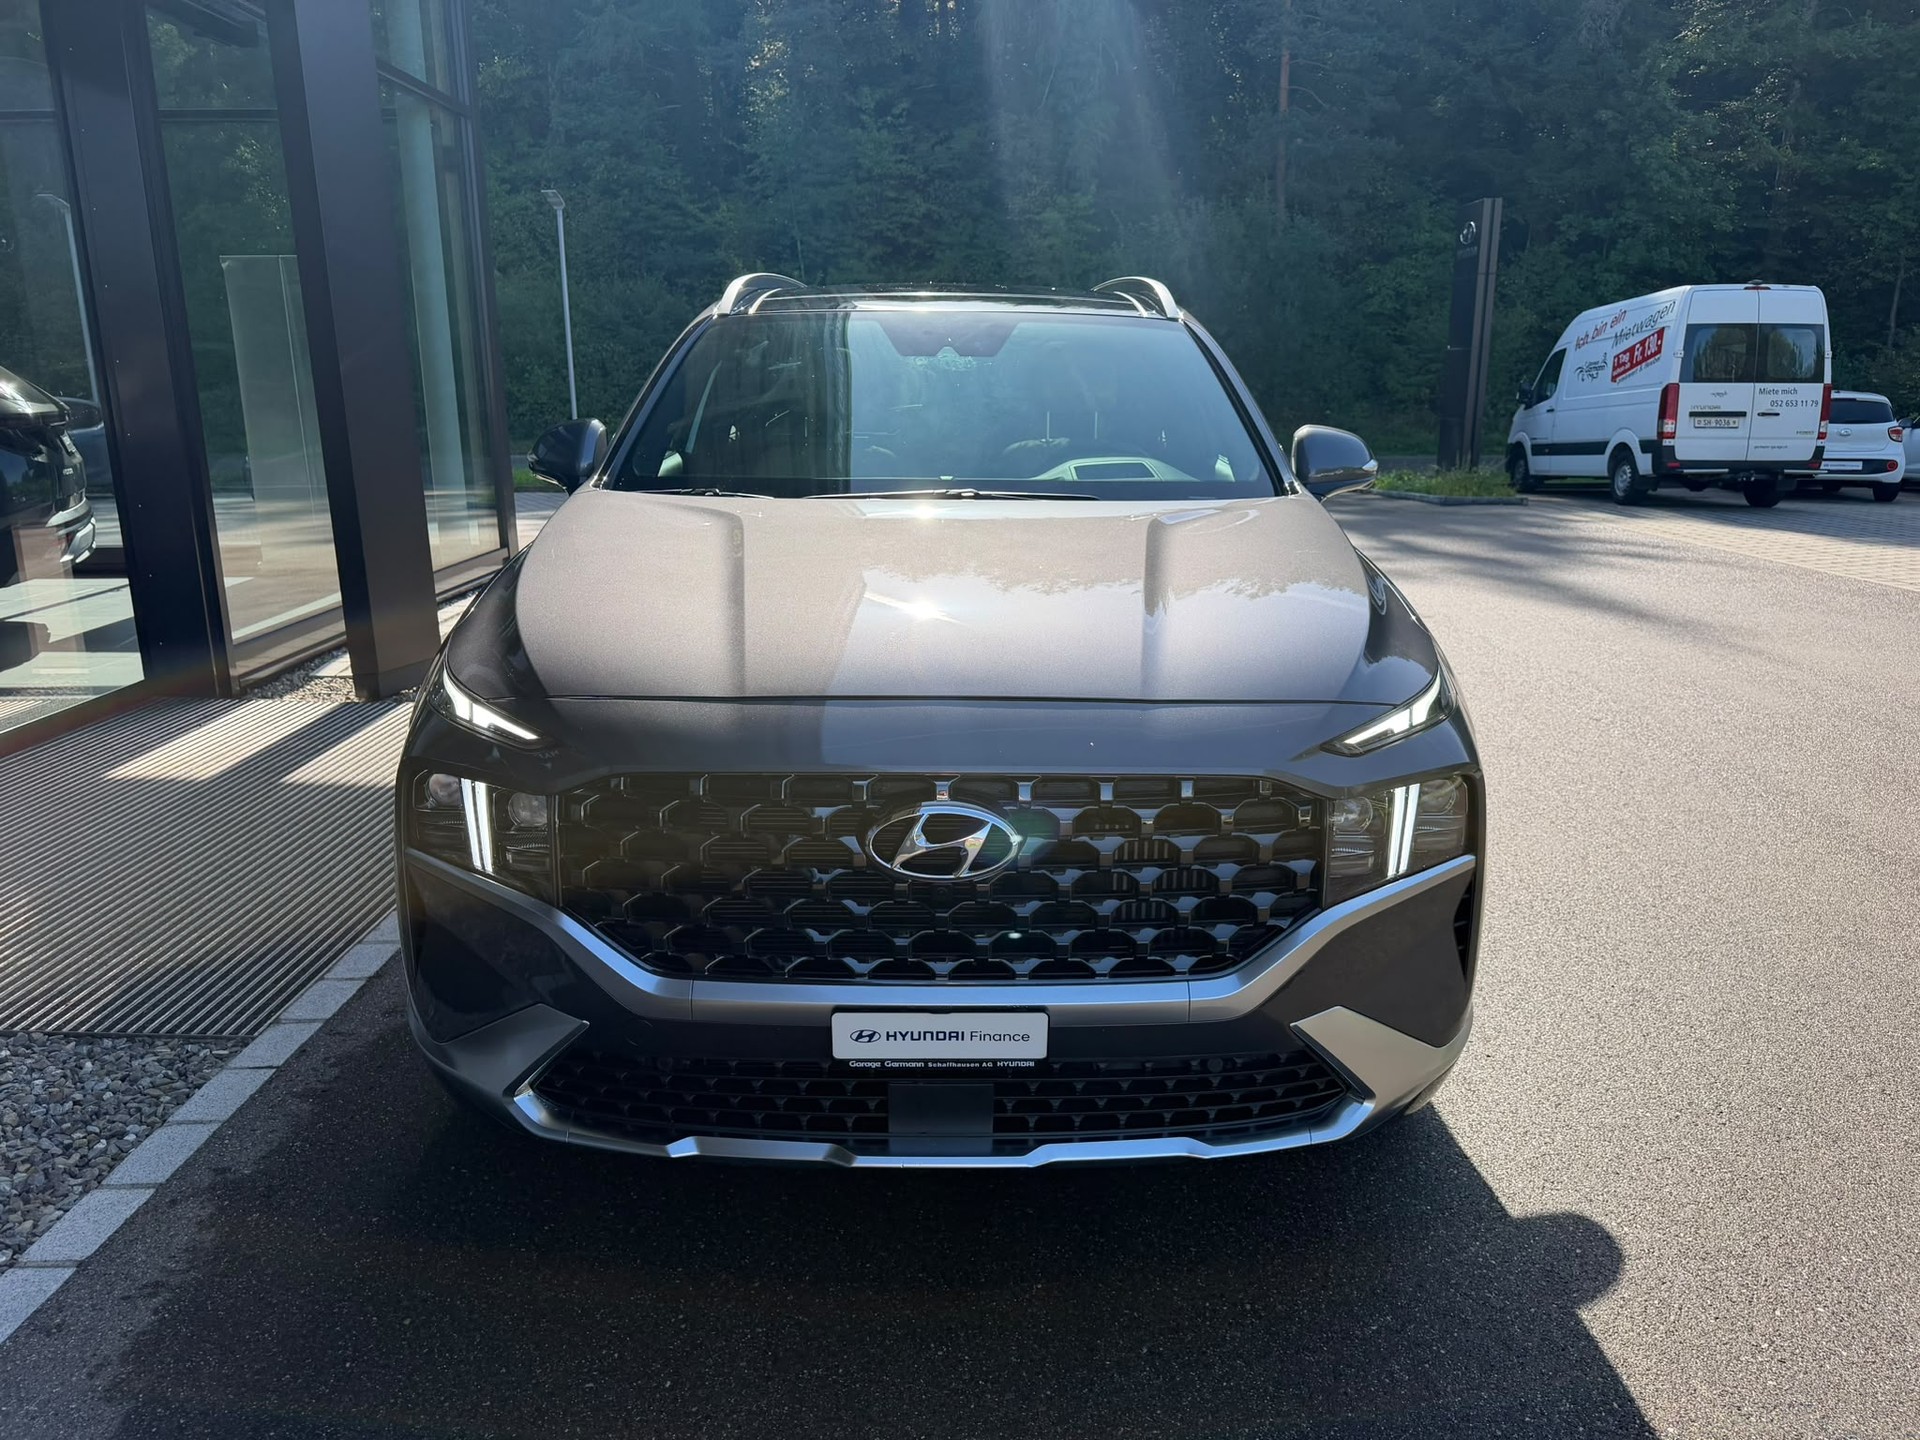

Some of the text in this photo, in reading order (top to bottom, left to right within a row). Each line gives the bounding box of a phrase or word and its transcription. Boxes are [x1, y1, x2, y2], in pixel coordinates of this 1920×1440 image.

[1575, 308, 1627, 351] Ich bin ein
[1612, 301, 1676, 349] Mietwagen
[1758, 387, 1798, 395] Miete mich
[886, 1031, 1030, 1041] HYUNDAI Finance
